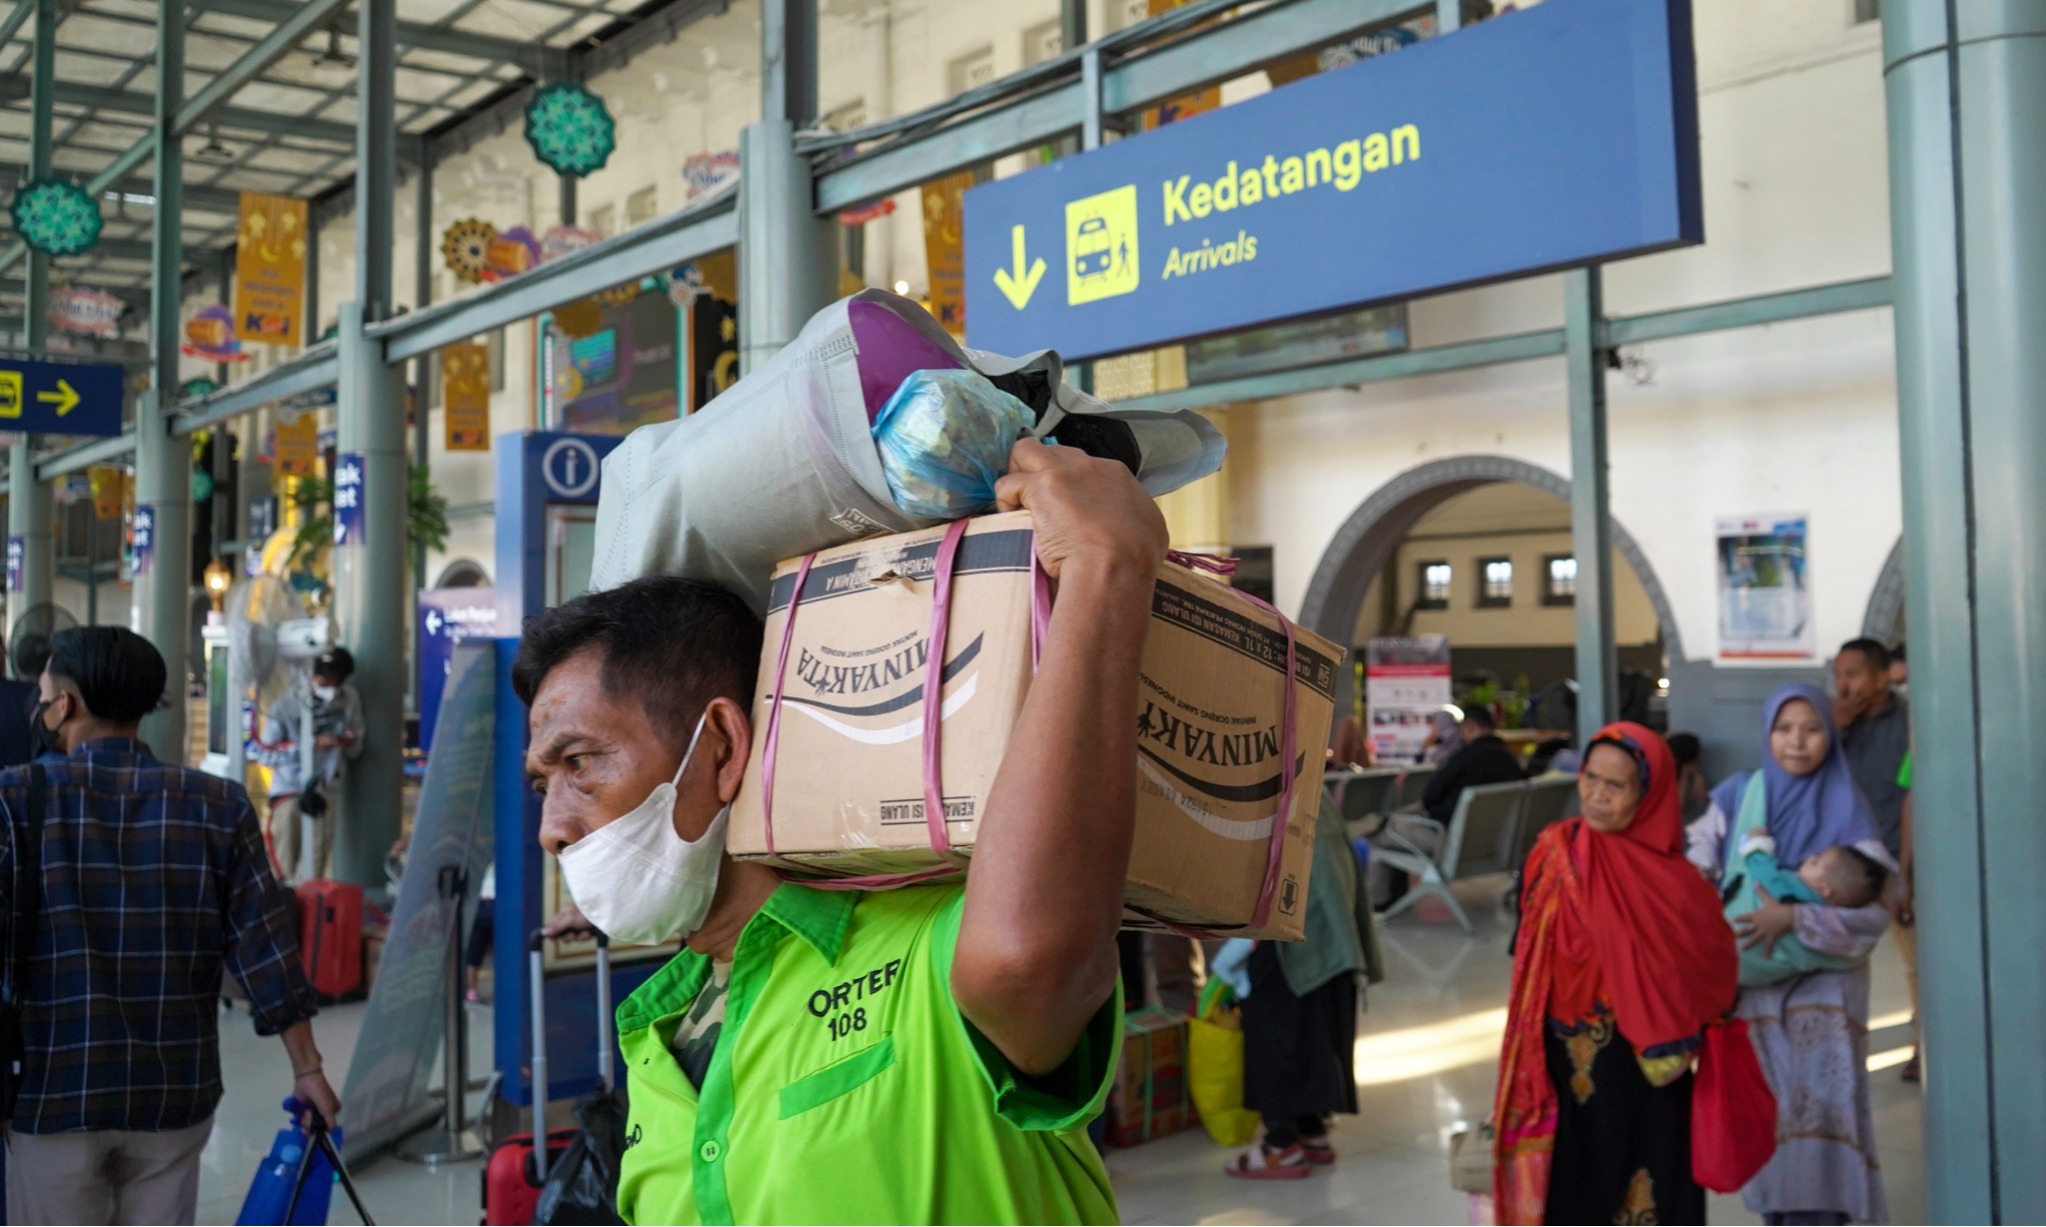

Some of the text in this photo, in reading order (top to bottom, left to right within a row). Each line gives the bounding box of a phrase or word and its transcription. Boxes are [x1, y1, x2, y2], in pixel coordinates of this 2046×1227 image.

[1162, 123, 1421, 227] Kedatangan
[1161, 229, 1258, 280] Arrivals
[1161, 601, 1190, 620] ULANG
[1191, 613, 1203, 627] ISI
[1203, 618, 1241, 643] KEMASAN
[1263, 646, 1273, 660] 12
[1176, 699, 1200, 717] SAWIT
[1200, 709, 1231, 725] GORENG
[1231, 715, 1256, 725] MINYAK
[880, 801, 975, 820] KEMA ISI ULANG
[807, 957, 902, 1018] ORTER
[827, 1006, 868, 1042] 108
